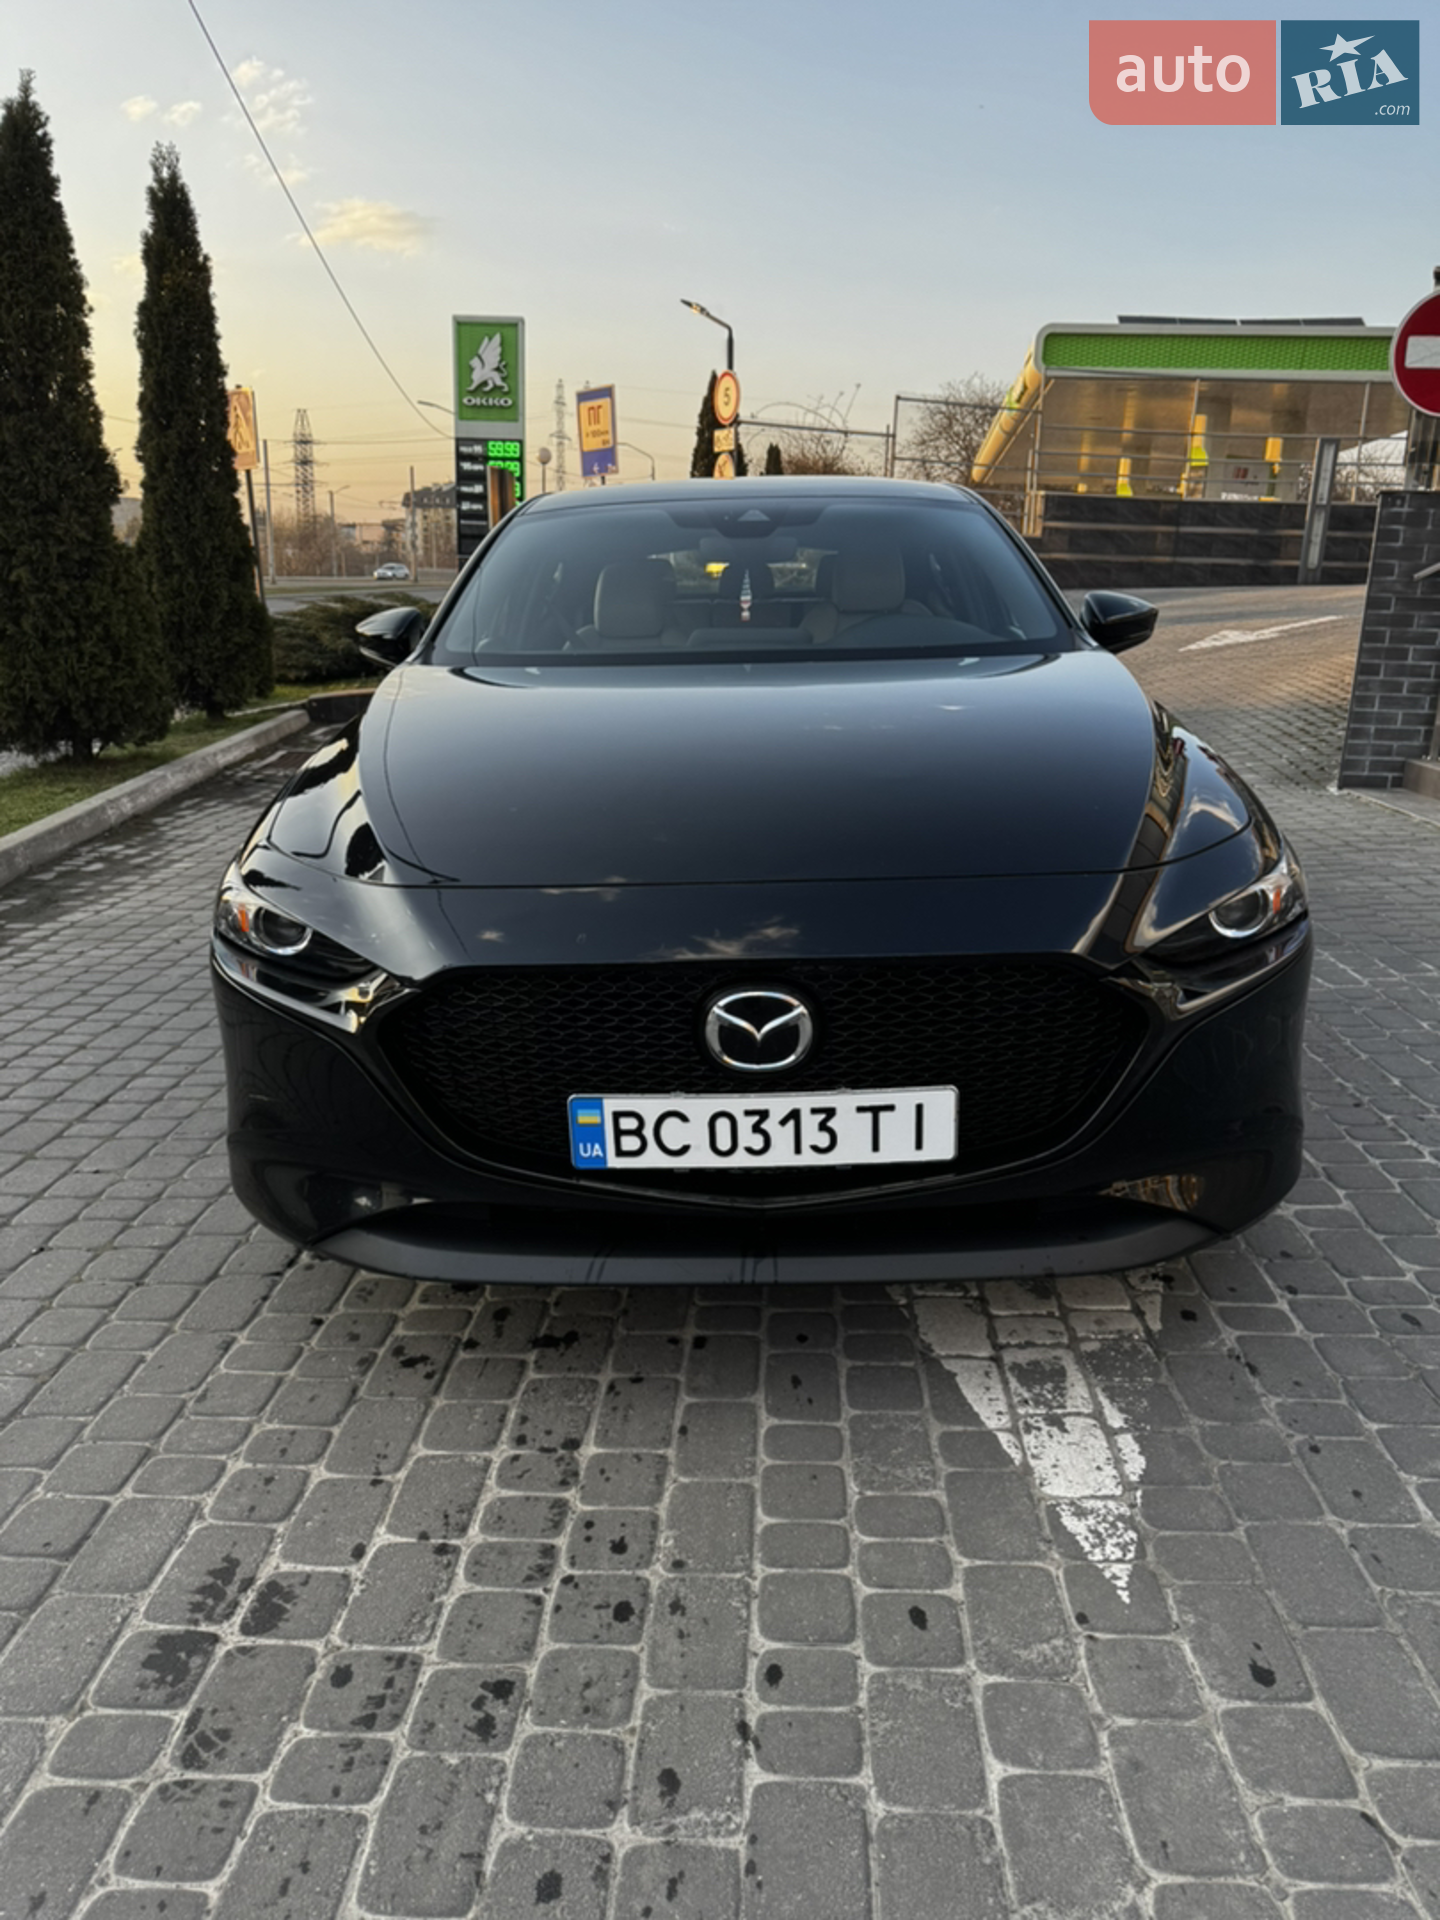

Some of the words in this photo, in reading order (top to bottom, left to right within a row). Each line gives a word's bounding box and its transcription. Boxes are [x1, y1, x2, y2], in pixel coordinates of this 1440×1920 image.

[462, 396, 513, 407] OKKO
[723, 386, 731, 407] 5
[588, 405, 603, 427] ПГ
[612, 1110, 691, 1158] BC
[708, 1107, 838, 1158] 0313
[579, 1143, 603, 1158] UA
